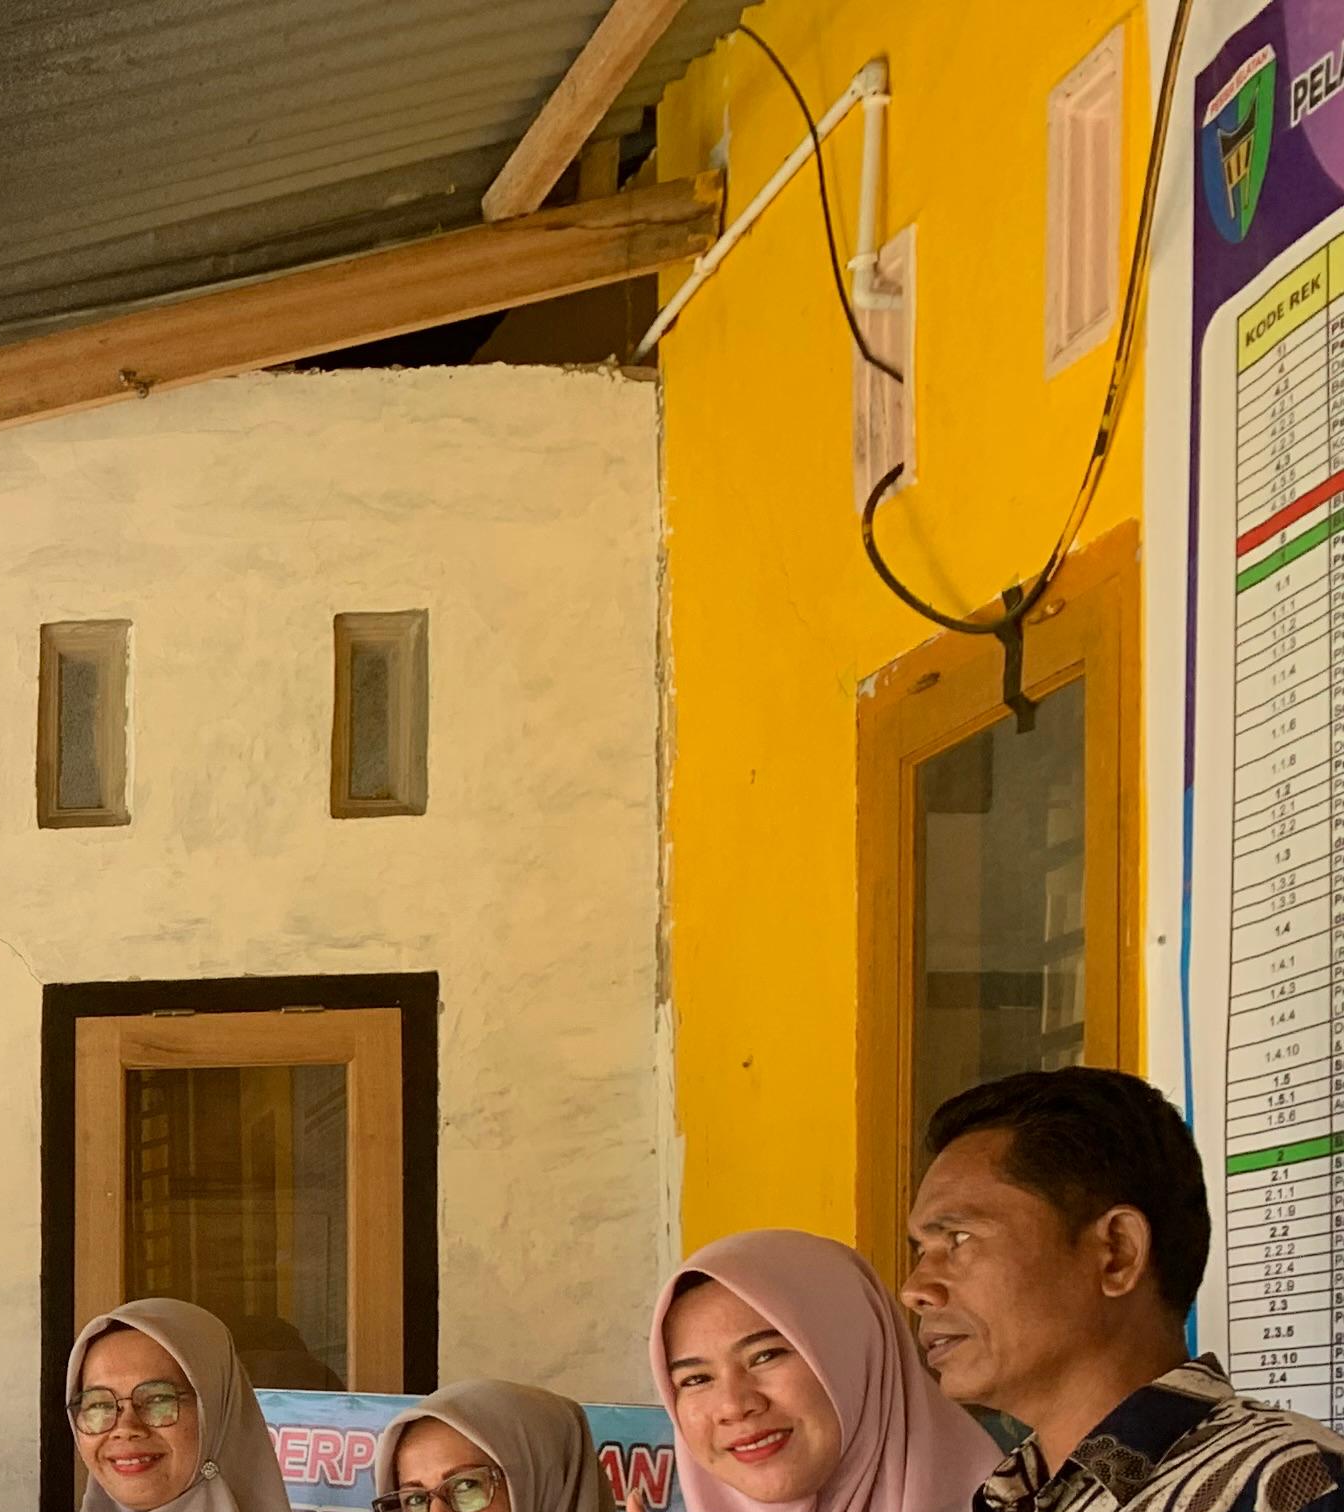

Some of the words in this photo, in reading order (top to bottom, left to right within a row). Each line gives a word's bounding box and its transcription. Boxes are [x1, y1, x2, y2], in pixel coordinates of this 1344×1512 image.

[1245, 302, 1285, 347] KODE
[1289, 273, 1322, 311] REK
[1271, 1168, 1289, 1182] 2.1
[1265, 1187, 1296, 1202] 2.1.1
[1269, 1225, 1290, 1239] 2.2
[1264, 1243, 1296, 1258] 2.2.2
[1264, 1263, 1295, 1277] 2.2.4
[1269, 1300, 1289, 1313] 2.3
[1260, 1352, 1299, 1366] 2.3.10
[1268, 1372, 1288, 1384] 2.4
